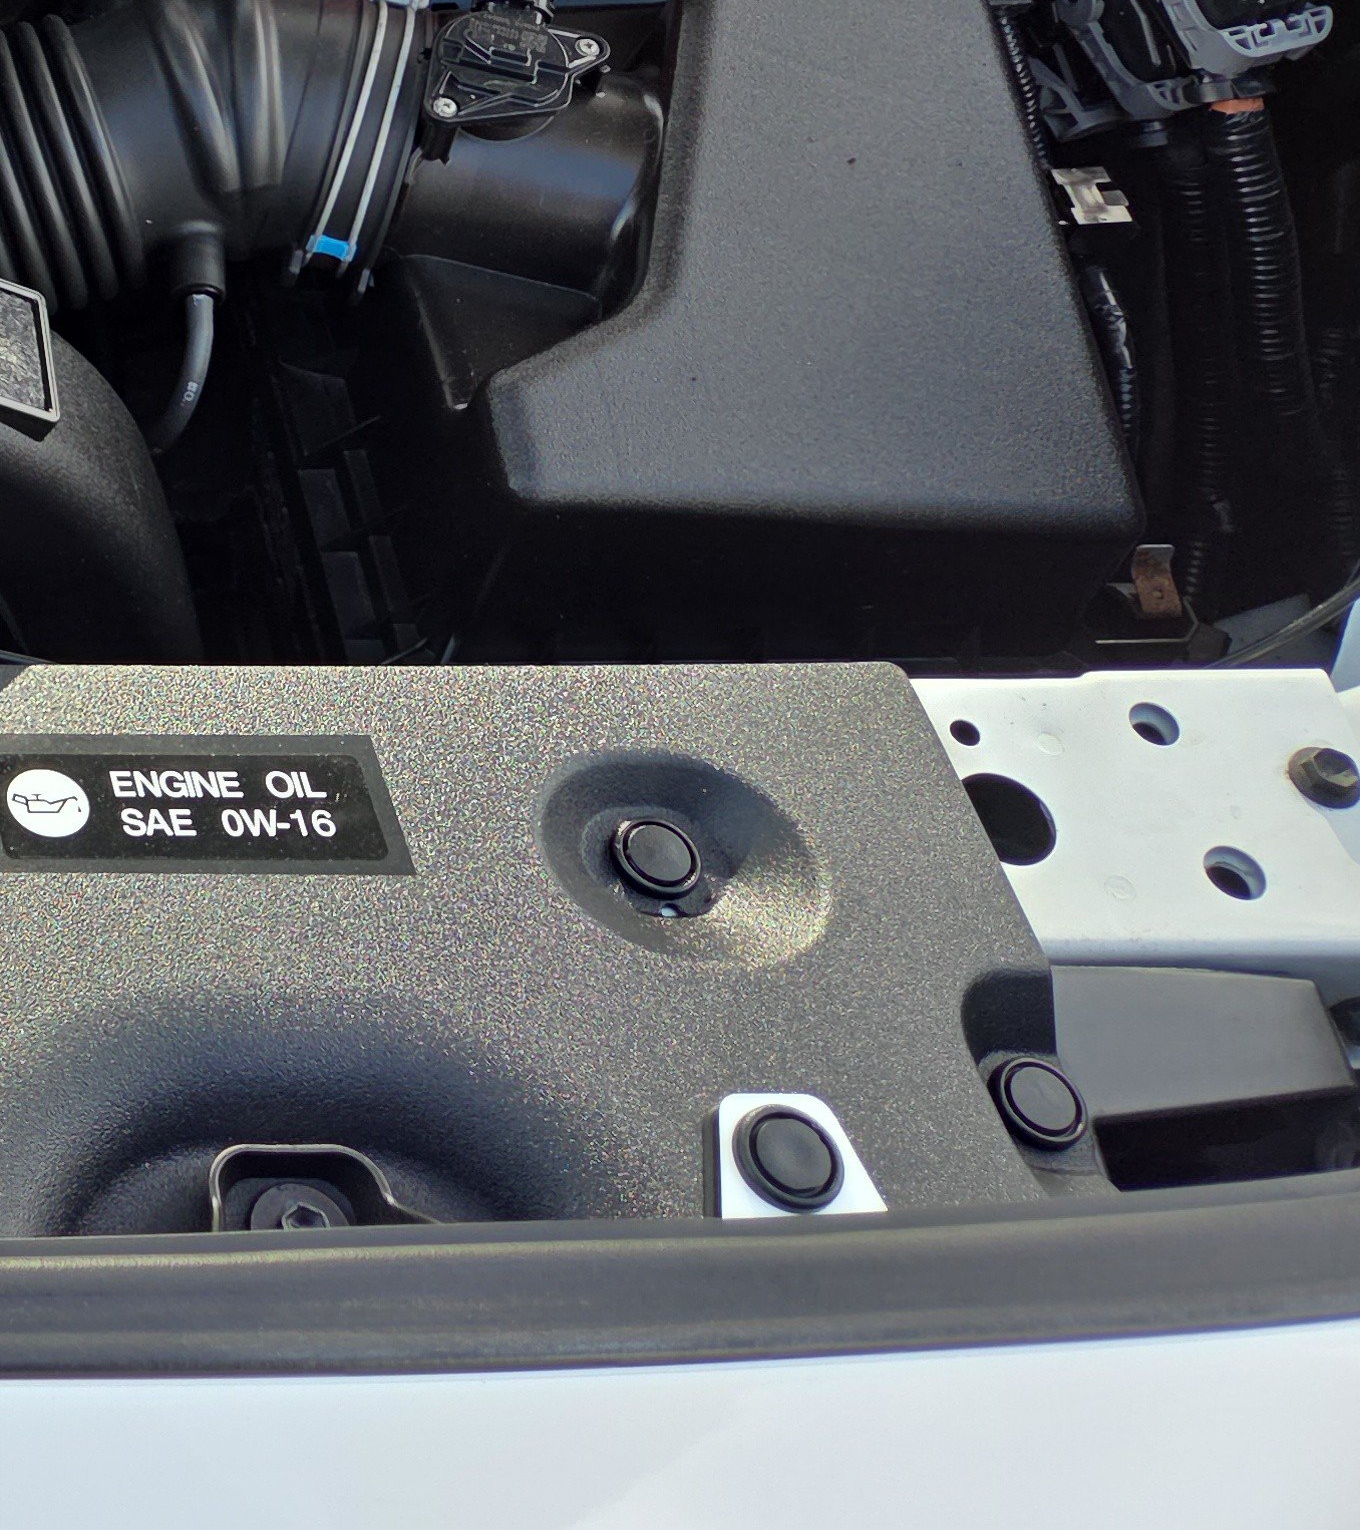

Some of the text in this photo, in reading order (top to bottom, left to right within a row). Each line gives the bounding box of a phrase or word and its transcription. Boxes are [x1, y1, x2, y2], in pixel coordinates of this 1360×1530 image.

[109, 770, 327, 799] ENGINE OIL
[121, 808, 337, 838] SAE 0W-16
